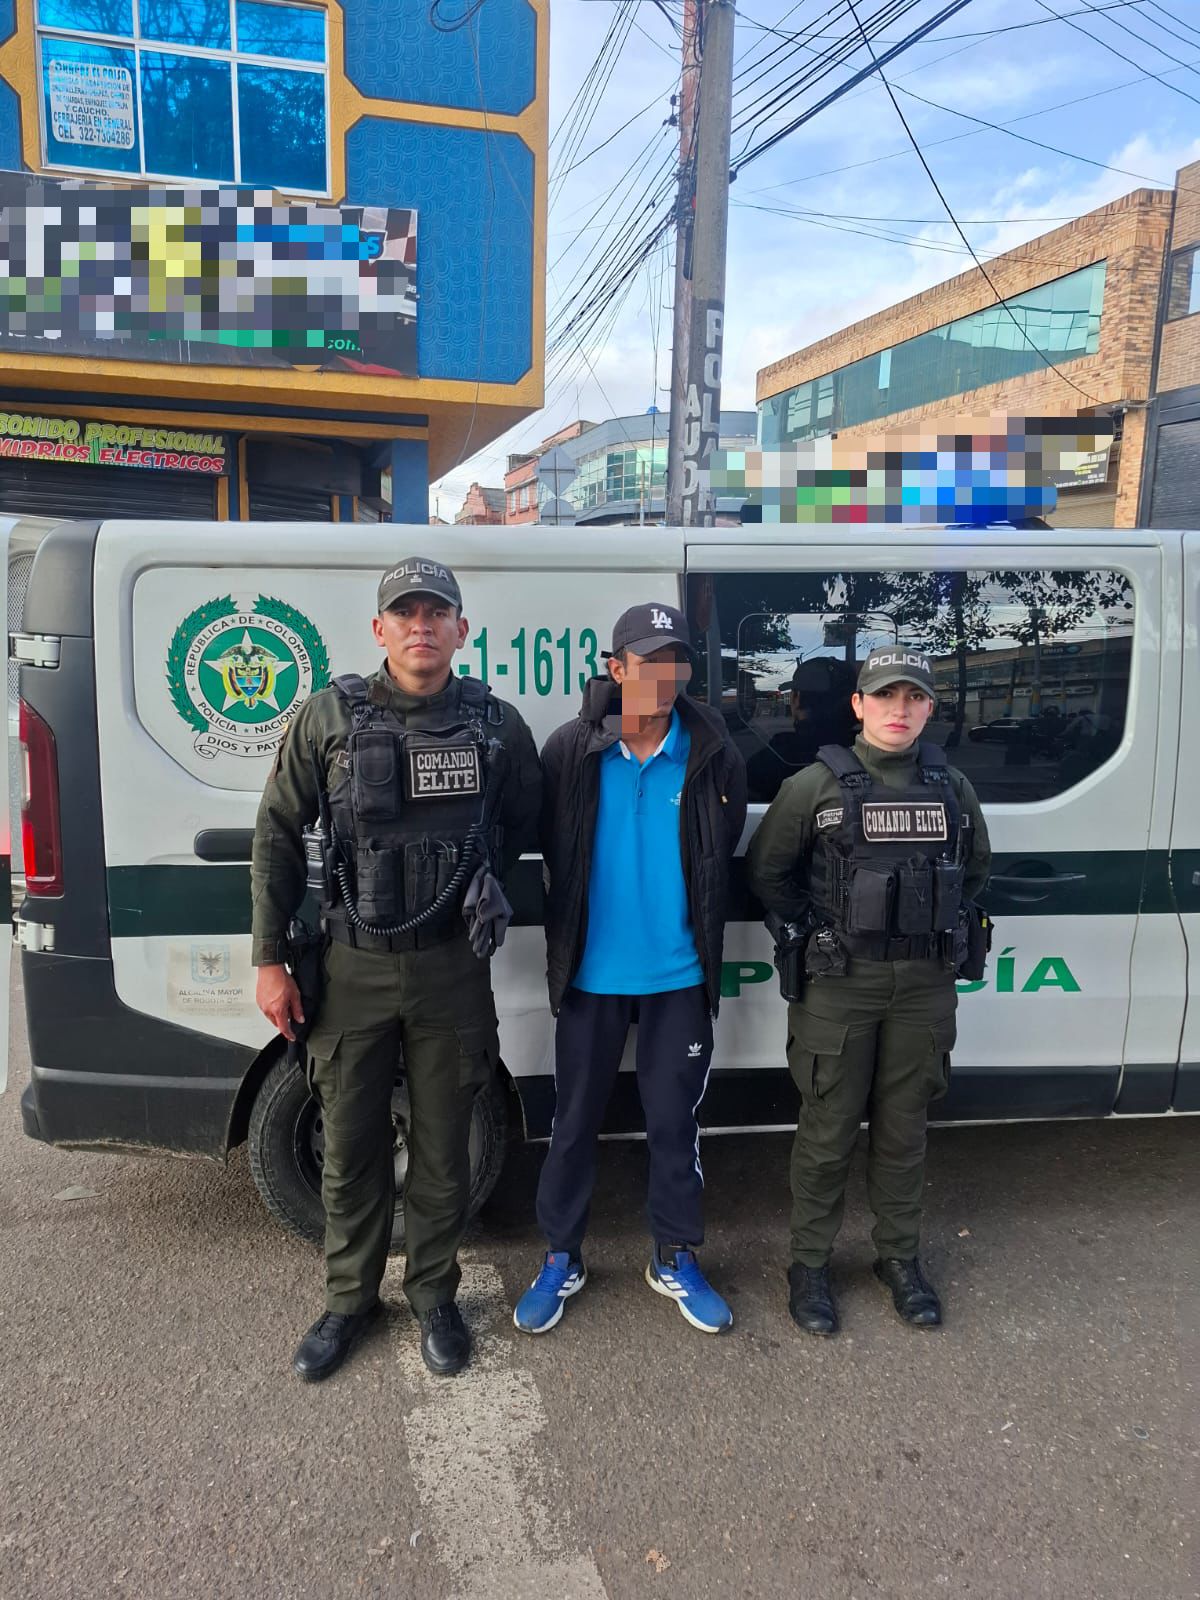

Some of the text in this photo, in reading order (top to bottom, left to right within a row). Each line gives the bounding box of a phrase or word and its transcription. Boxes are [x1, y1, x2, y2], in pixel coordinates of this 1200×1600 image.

[58, 125, 74, 139] CEL
[94, 116, 102, 127] EN
[0, 413, 226, 455] SONIDO PROFESIONAL
[0, 438, 225, 473] VIDRIOS ELECTRICOS
[650, 608, 674, 630] LA
[186, 616, 311, 676] REPUBLICA DE COLOMBIA
[254, 699, 305, 734] NACIONAL
[207, 736, 239, 751] DIOS
[243, 745, 251, 753] Y
[416, 751, 474, 770] COMANDO
[417, 769, 476, 792] ELITE
[865, 810, 945, 833] COMANDO ELITE
